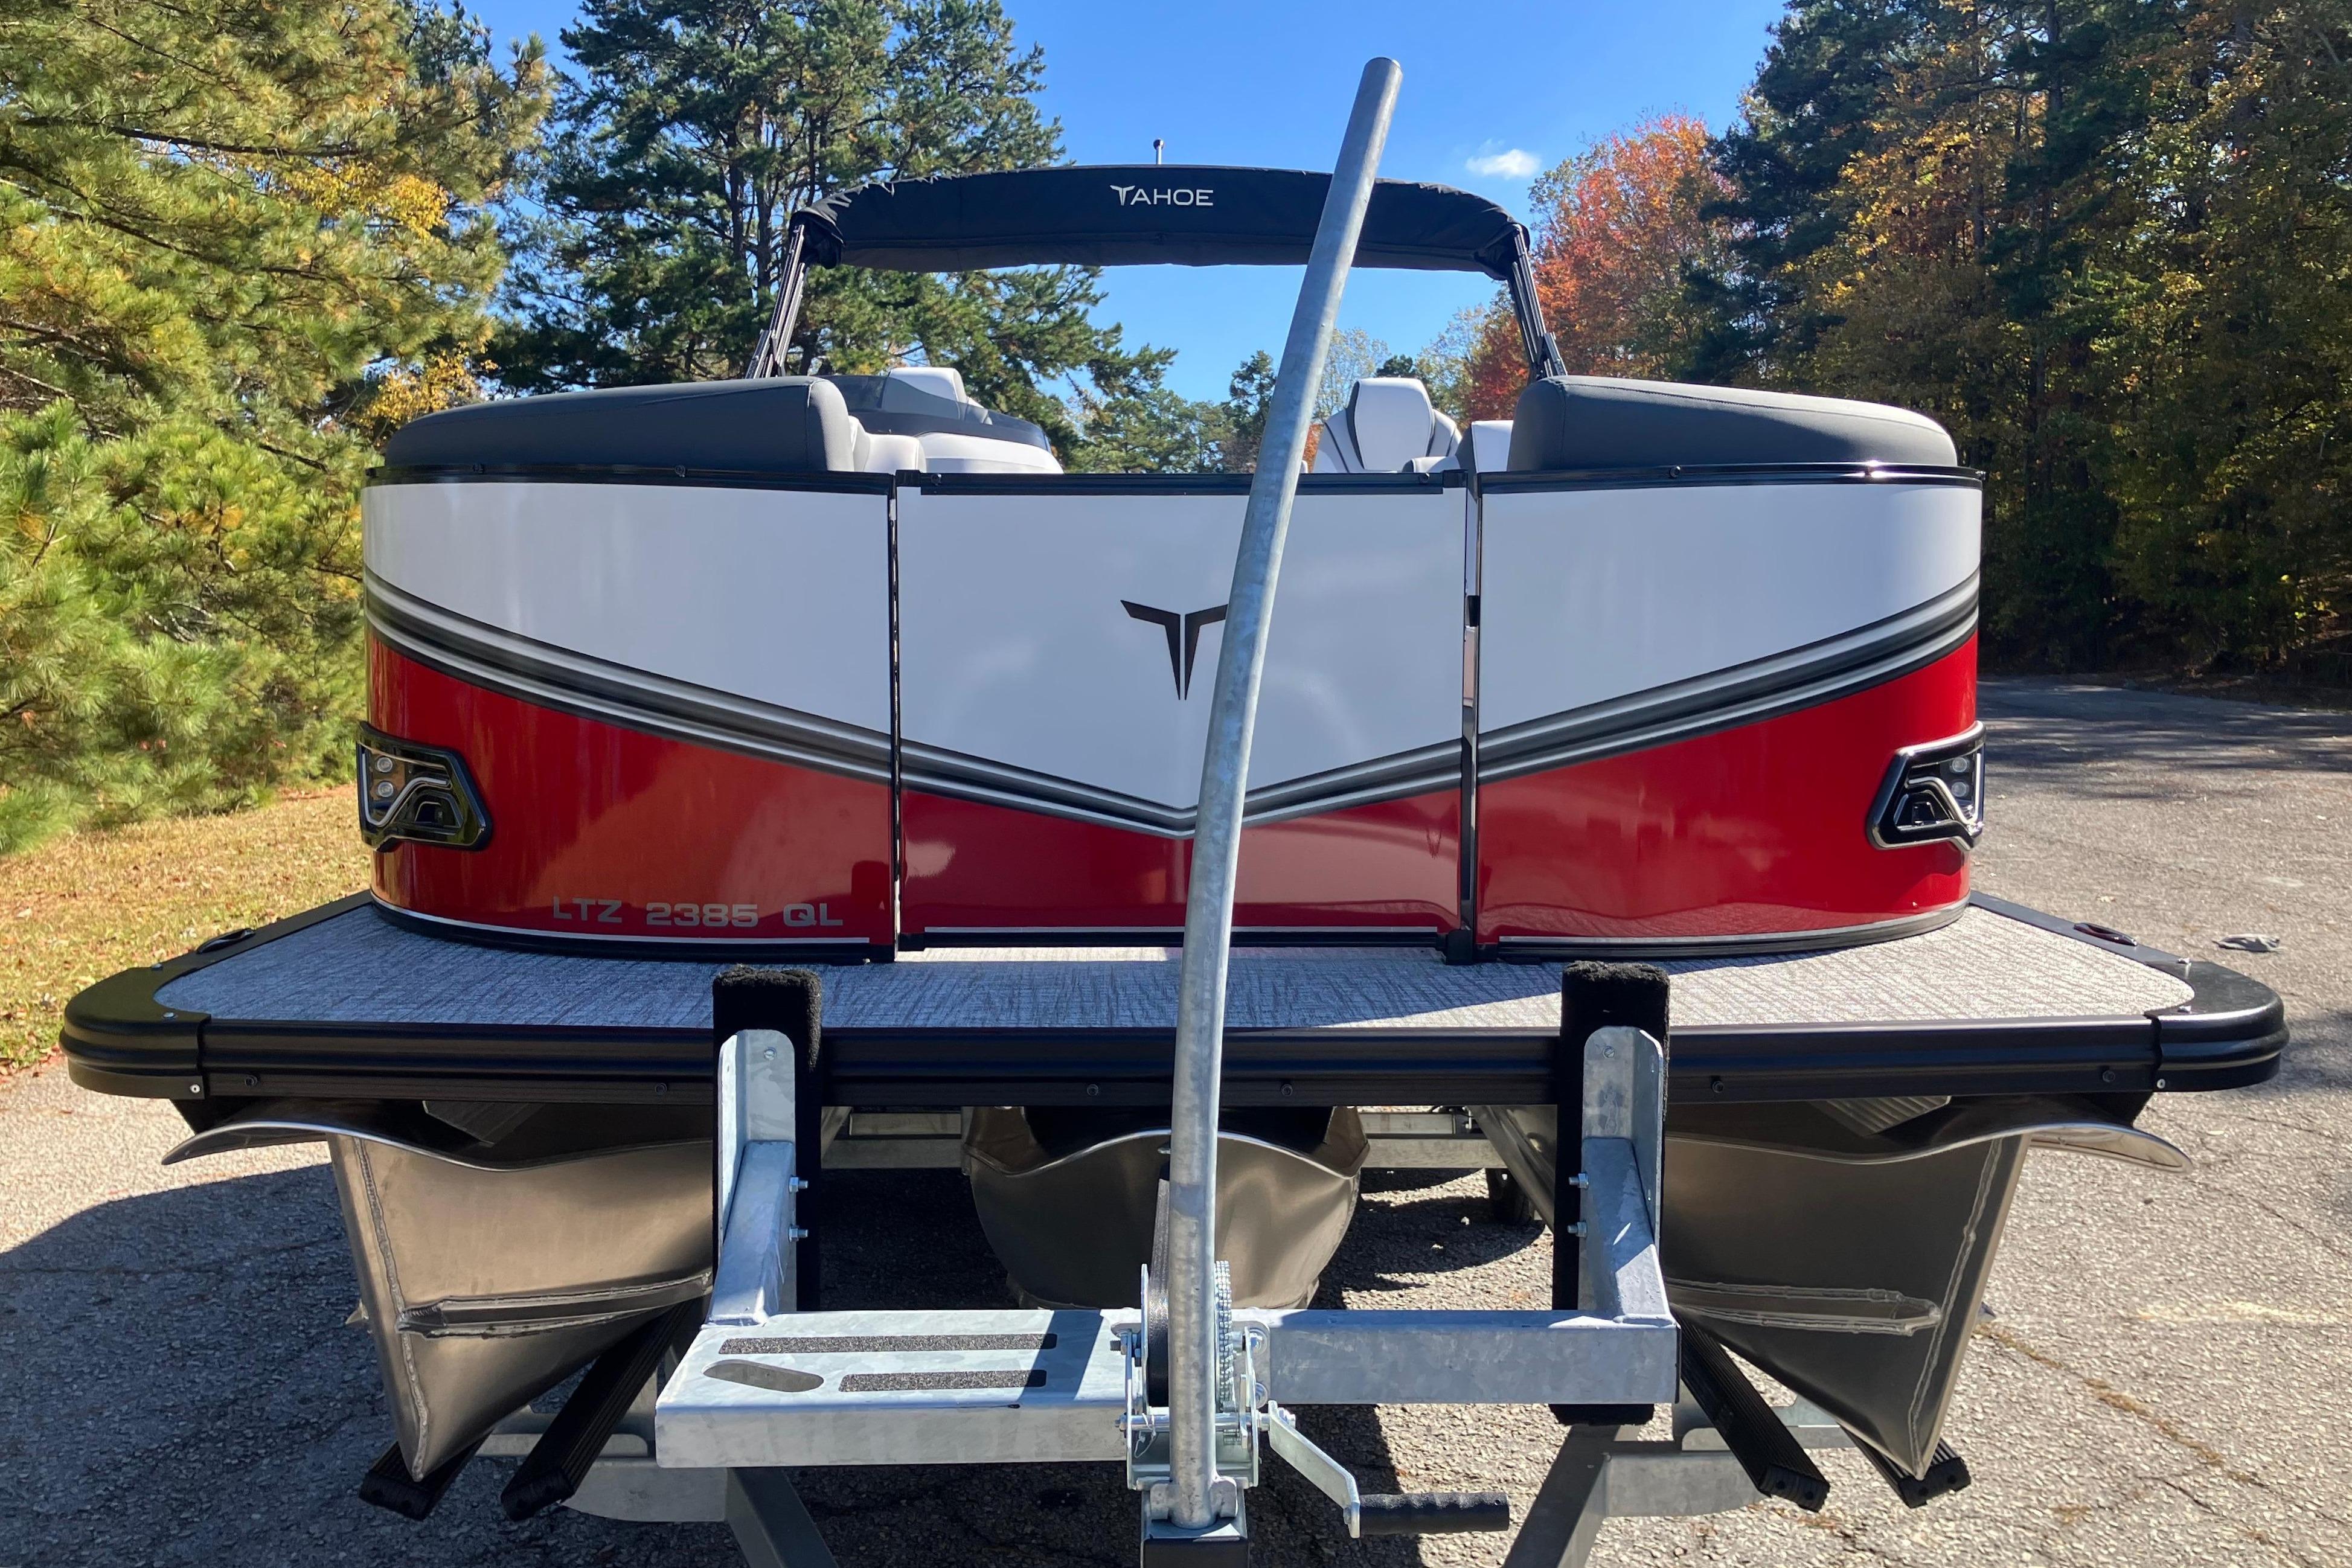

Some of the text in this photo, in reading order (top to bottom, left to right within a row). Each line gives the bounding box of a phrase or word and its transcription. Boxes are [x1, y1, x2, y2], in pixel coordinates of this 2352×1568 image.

[1110, 185, 1214, 206] TAHOE
[553, 897, 844, 927] LTZ 2385 QL
